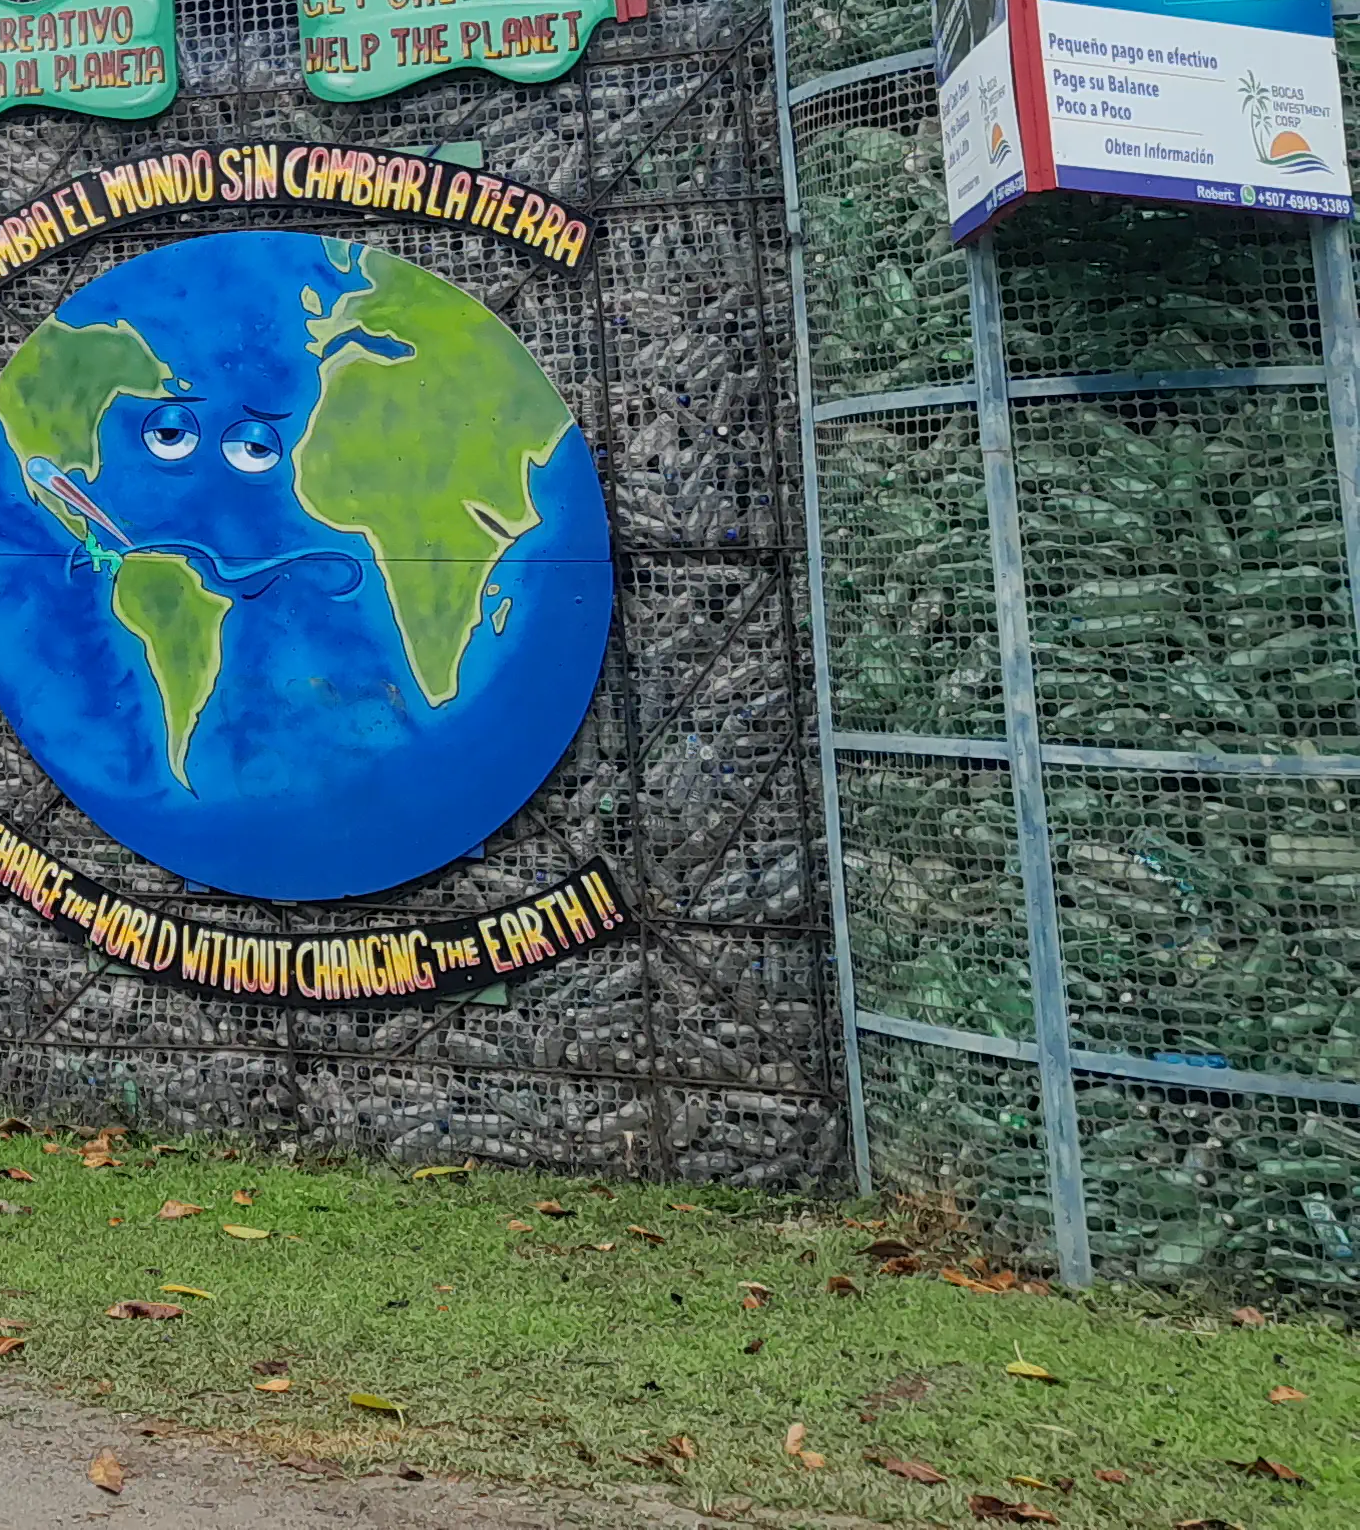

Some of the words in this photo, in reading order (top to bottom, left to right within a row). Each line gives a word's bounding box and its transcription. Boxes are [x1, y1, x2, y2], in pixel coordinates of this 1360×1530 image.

[305, 33, 380, 74] HELP
[391, 24, 452, 67] THE
[460, 11, 582, 60] PLANET
[1048, 32, 1108, 58] Pequeño
[1111, 44, 1144, 64] pago
[1148, 48, 1164, 63] en
[1167, 47, 1218, 70] efectivo
[15, 58, 44, 97] AL
[54, 46, 165, 93] PLANETA
[1053, 68, 1085, 93] Page
[1089, 75, 1105, 90] su
[1108, 75, 1160, 98] Balance
[1056, 95, 1086, 116] Poco
[1090, 102, 1098, 117] a
[1101, 100, 1132, 120] Poco
[1271, 85, 1304, 100] BOCAS
[1273, 101, 1331, 118] INVESTMENT
[1105, 138, 1141, 157] Obten
[1144, 142, 1214, 165] Información
[53, 181, 106, 237] EL
[100, 149, 214, 218] MUNDO
[425, 163, 472, 220] LA
[60, 889, 97, 929] THE
[89, 893, 177, 972] WORLD
[430, 937, 481, 972] THE
